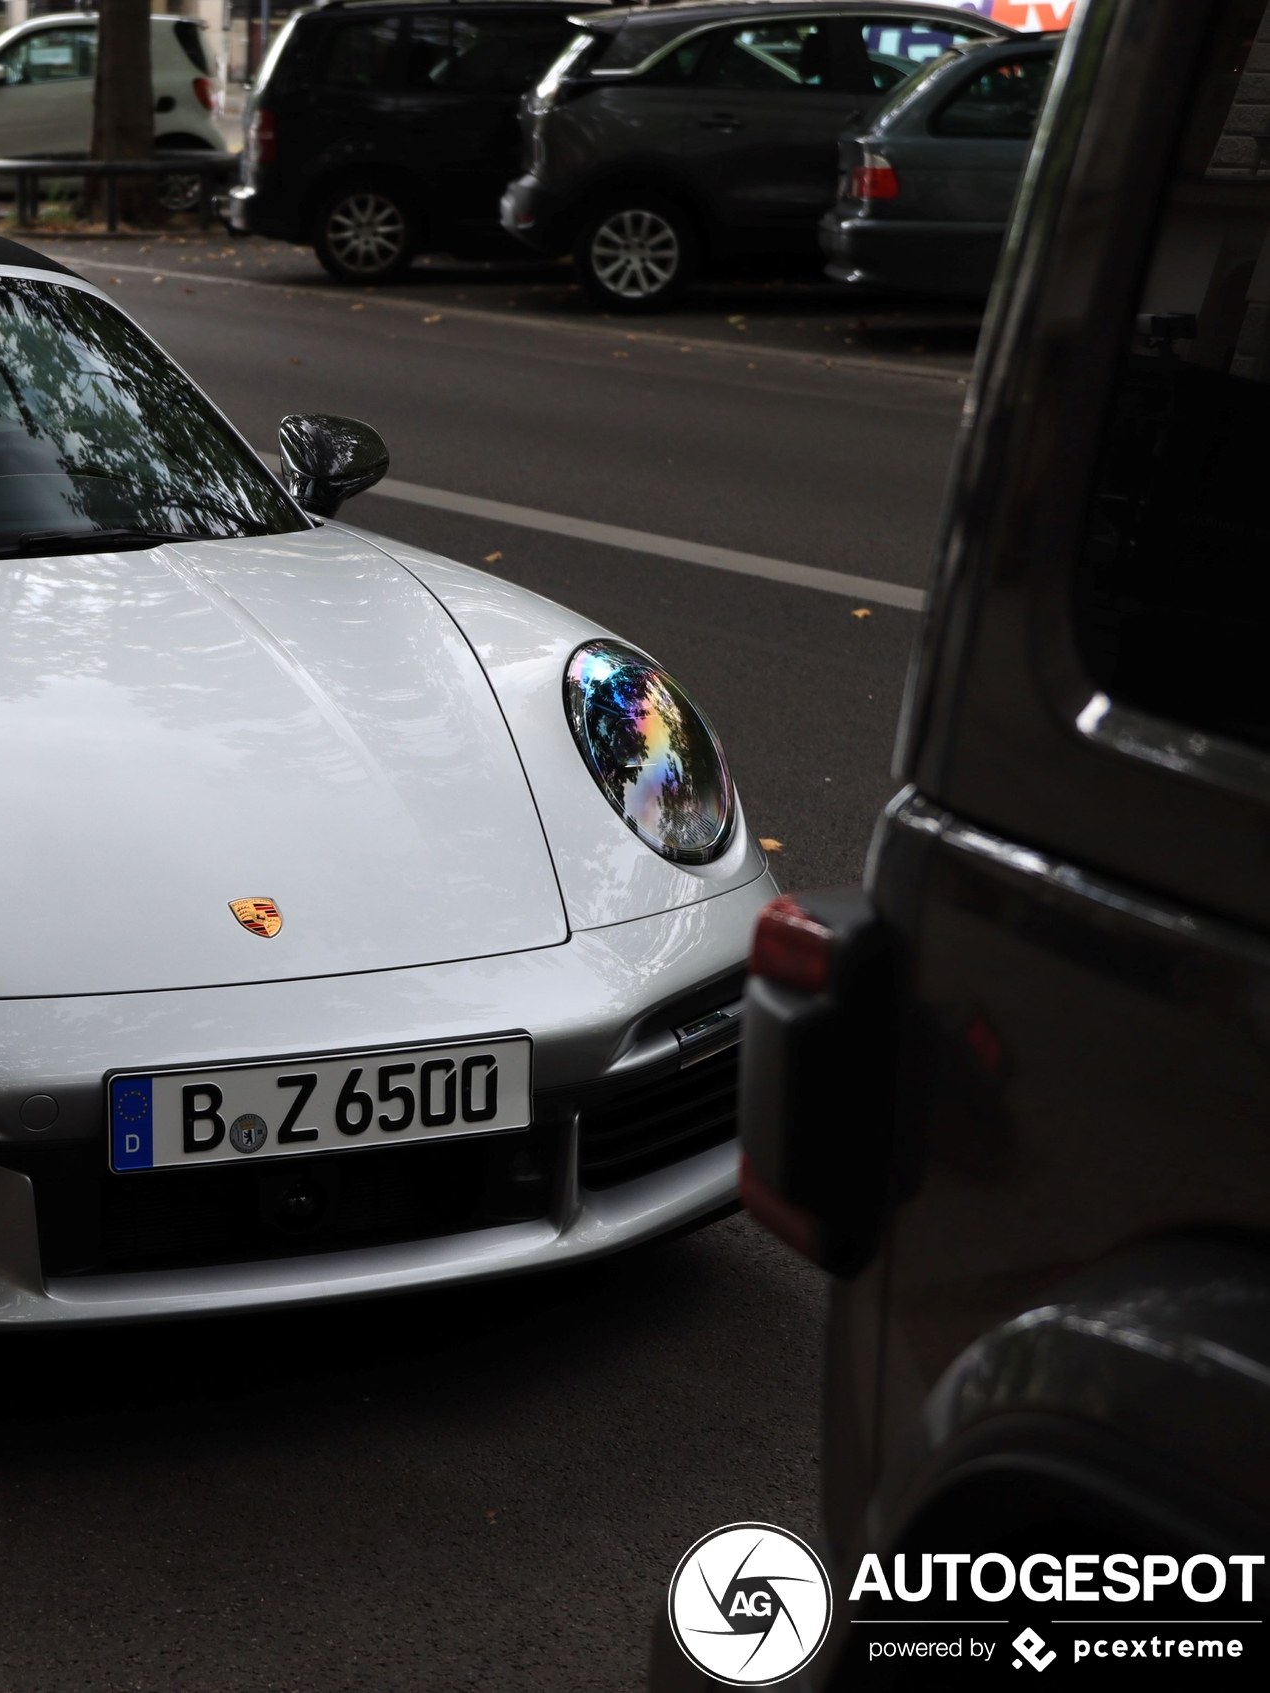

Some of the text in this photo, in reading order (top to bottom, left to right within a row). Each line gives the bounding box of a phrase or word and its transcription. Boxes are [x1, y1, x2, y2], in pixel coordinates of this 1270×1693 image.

[182, 1054, 498, 1153] B Z 6500
[125, 1134, 140, 1154] D
